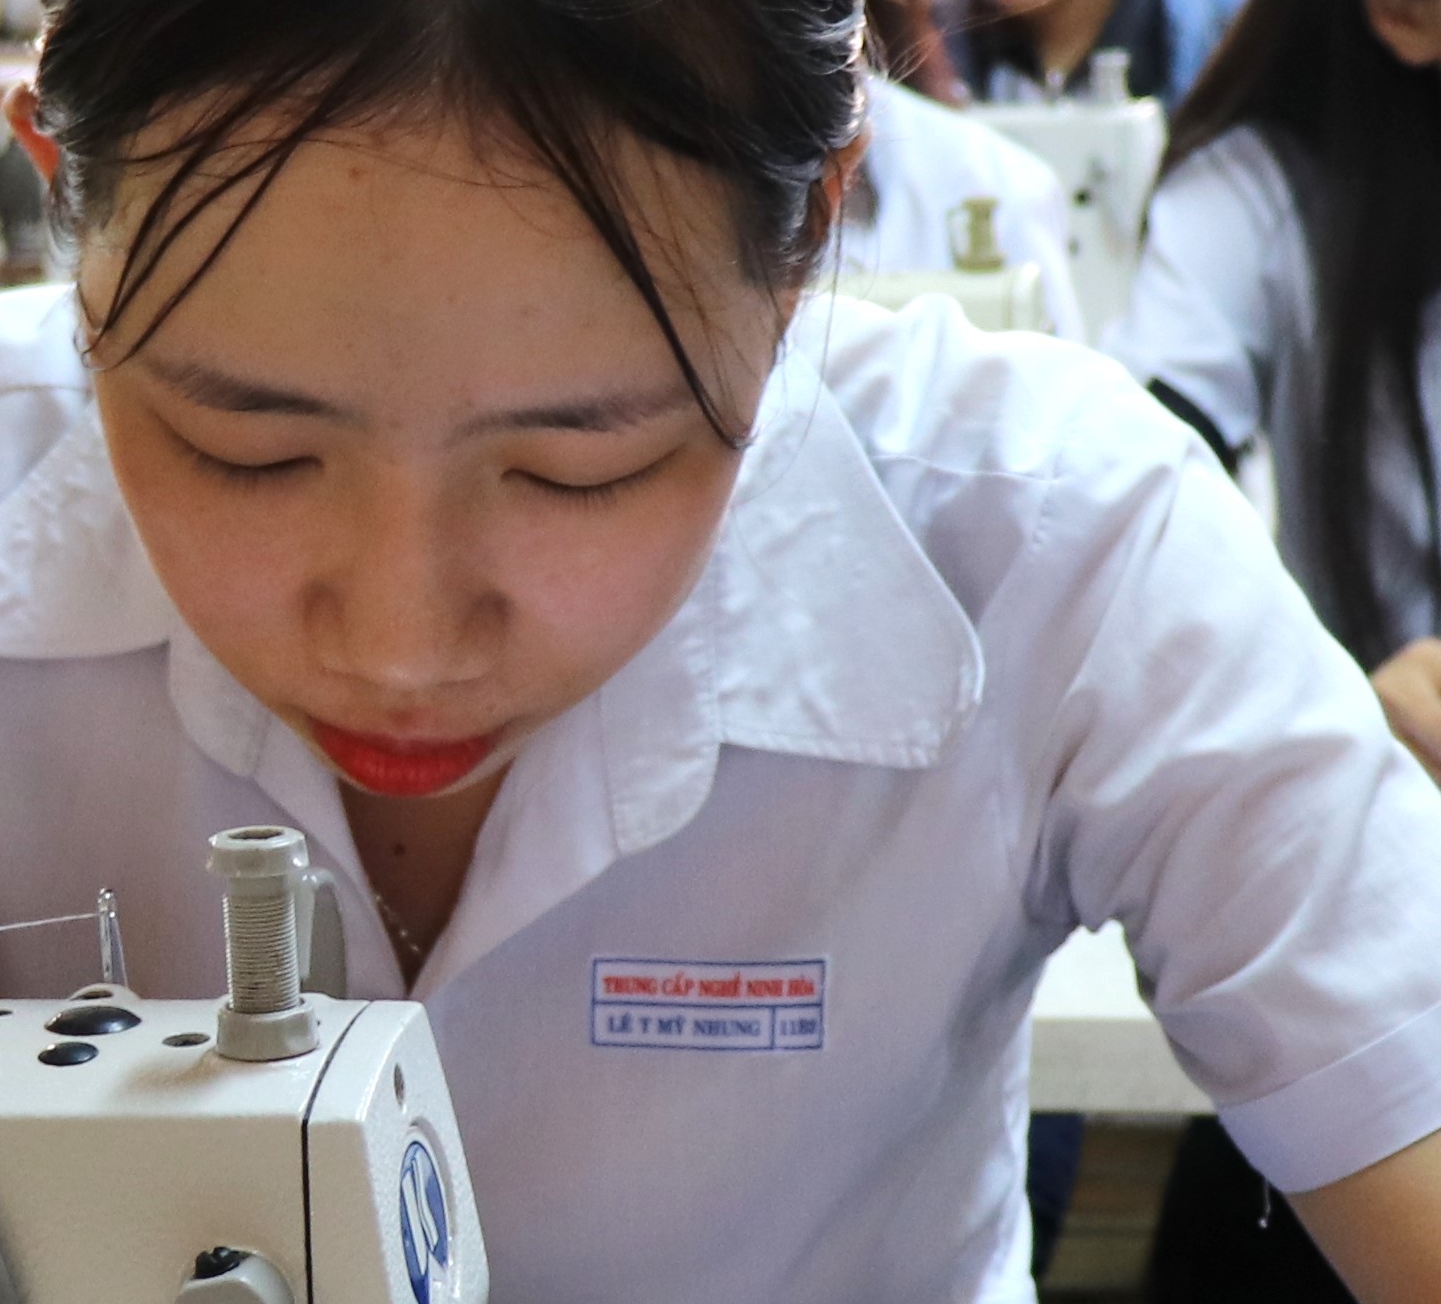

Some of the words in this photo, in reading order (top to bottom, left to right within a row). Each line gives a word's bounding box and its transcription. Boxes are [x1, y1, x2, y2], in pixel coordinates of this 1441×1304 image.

[603, 976, 658, 995] TRUNG
[639, 1016, 652, 1034] T
[693, 1019, 761, 1036] NHUNG
